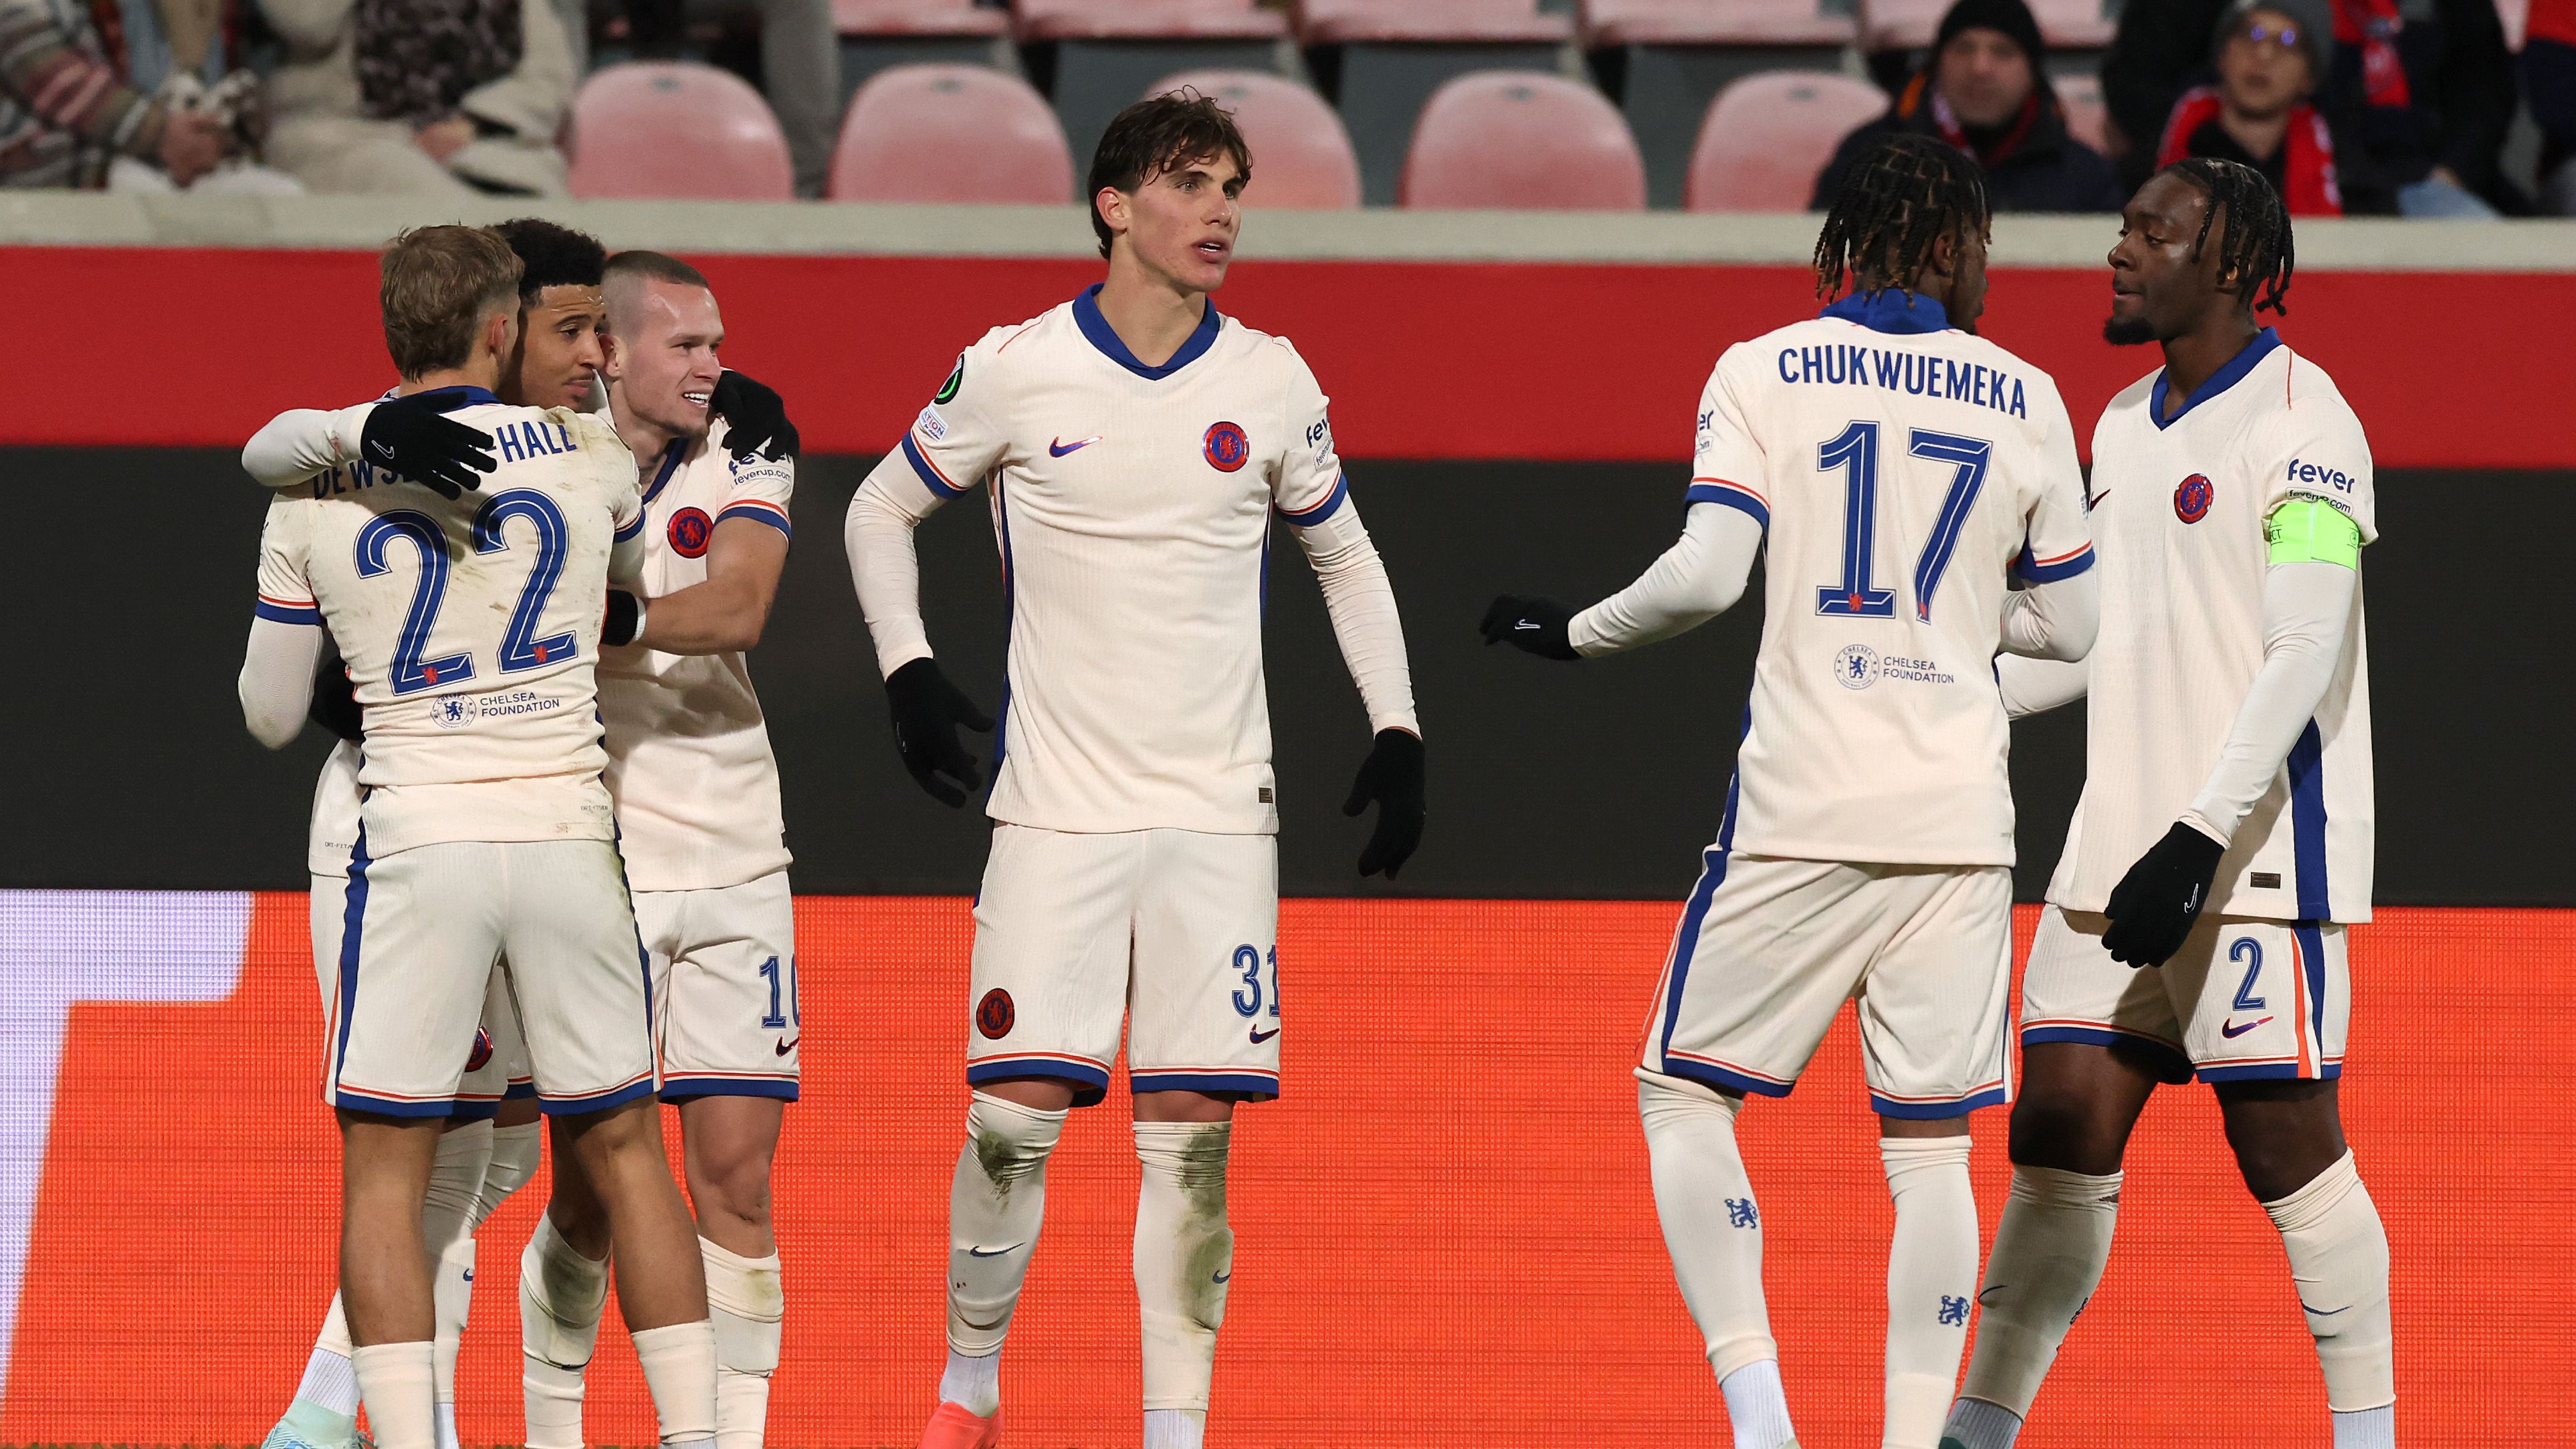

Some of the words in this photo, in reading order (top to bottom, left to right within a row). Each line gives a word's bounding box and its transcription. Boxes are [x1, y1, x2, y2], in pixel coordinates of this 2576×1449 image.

[1778, 344, 2027, 420] CHUKWUEMEKA
[2287, 459, 2355, 493] fever
[1816, 420, 1993, 625] 17
[353, 487, 578, 696] 22
[1883, 657, 1936, 671] CHELSEA
[1883, 669, 1954, 683] FOUNDATION
[480, 691, 536, 705] CHELSEA
[481, 699, 560, 717] FOUNDATION
[2228, 937, 2266, 1011] 2
